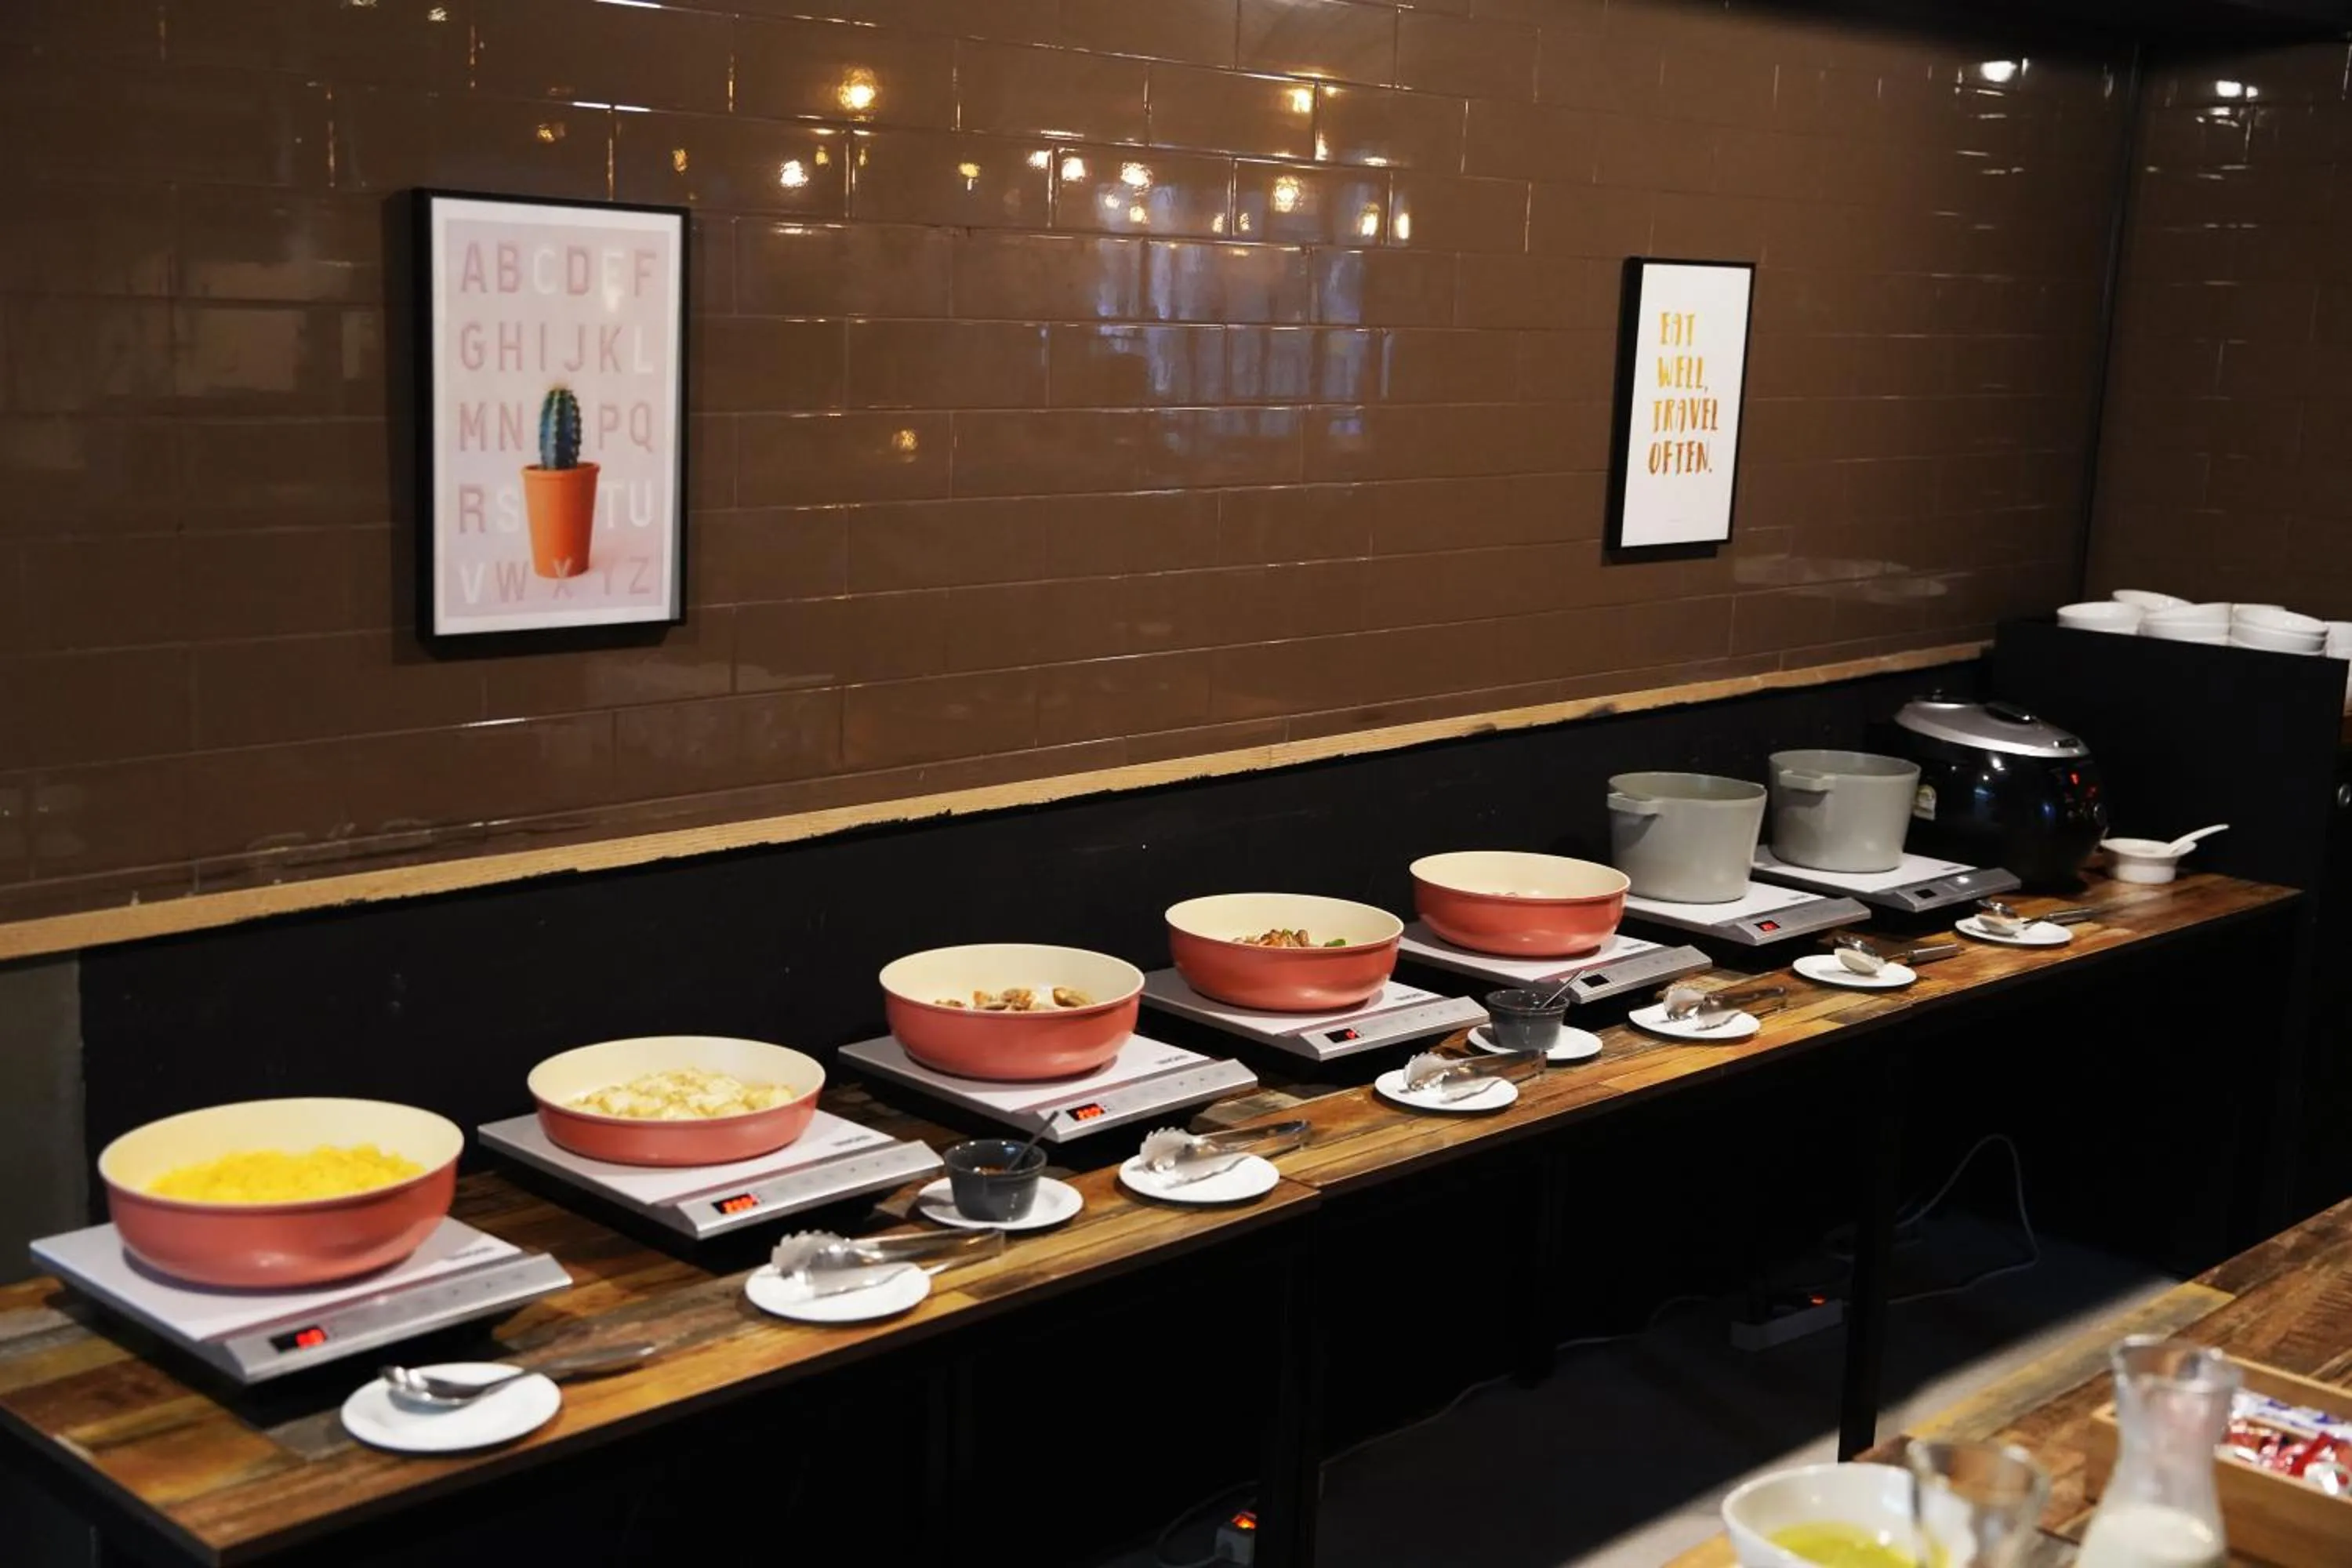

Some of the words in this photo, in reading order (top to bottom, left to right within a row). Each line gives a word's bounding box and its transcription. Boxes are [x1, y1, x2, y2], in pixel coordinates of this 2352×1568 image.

[1660, 311, 1695, 346] EAT
[1657, 355, 1709, 392] WELL,
[1653, 397, 1719, 433] TRAVEL
[1648, 439, 1713, 475] OFTEN.
